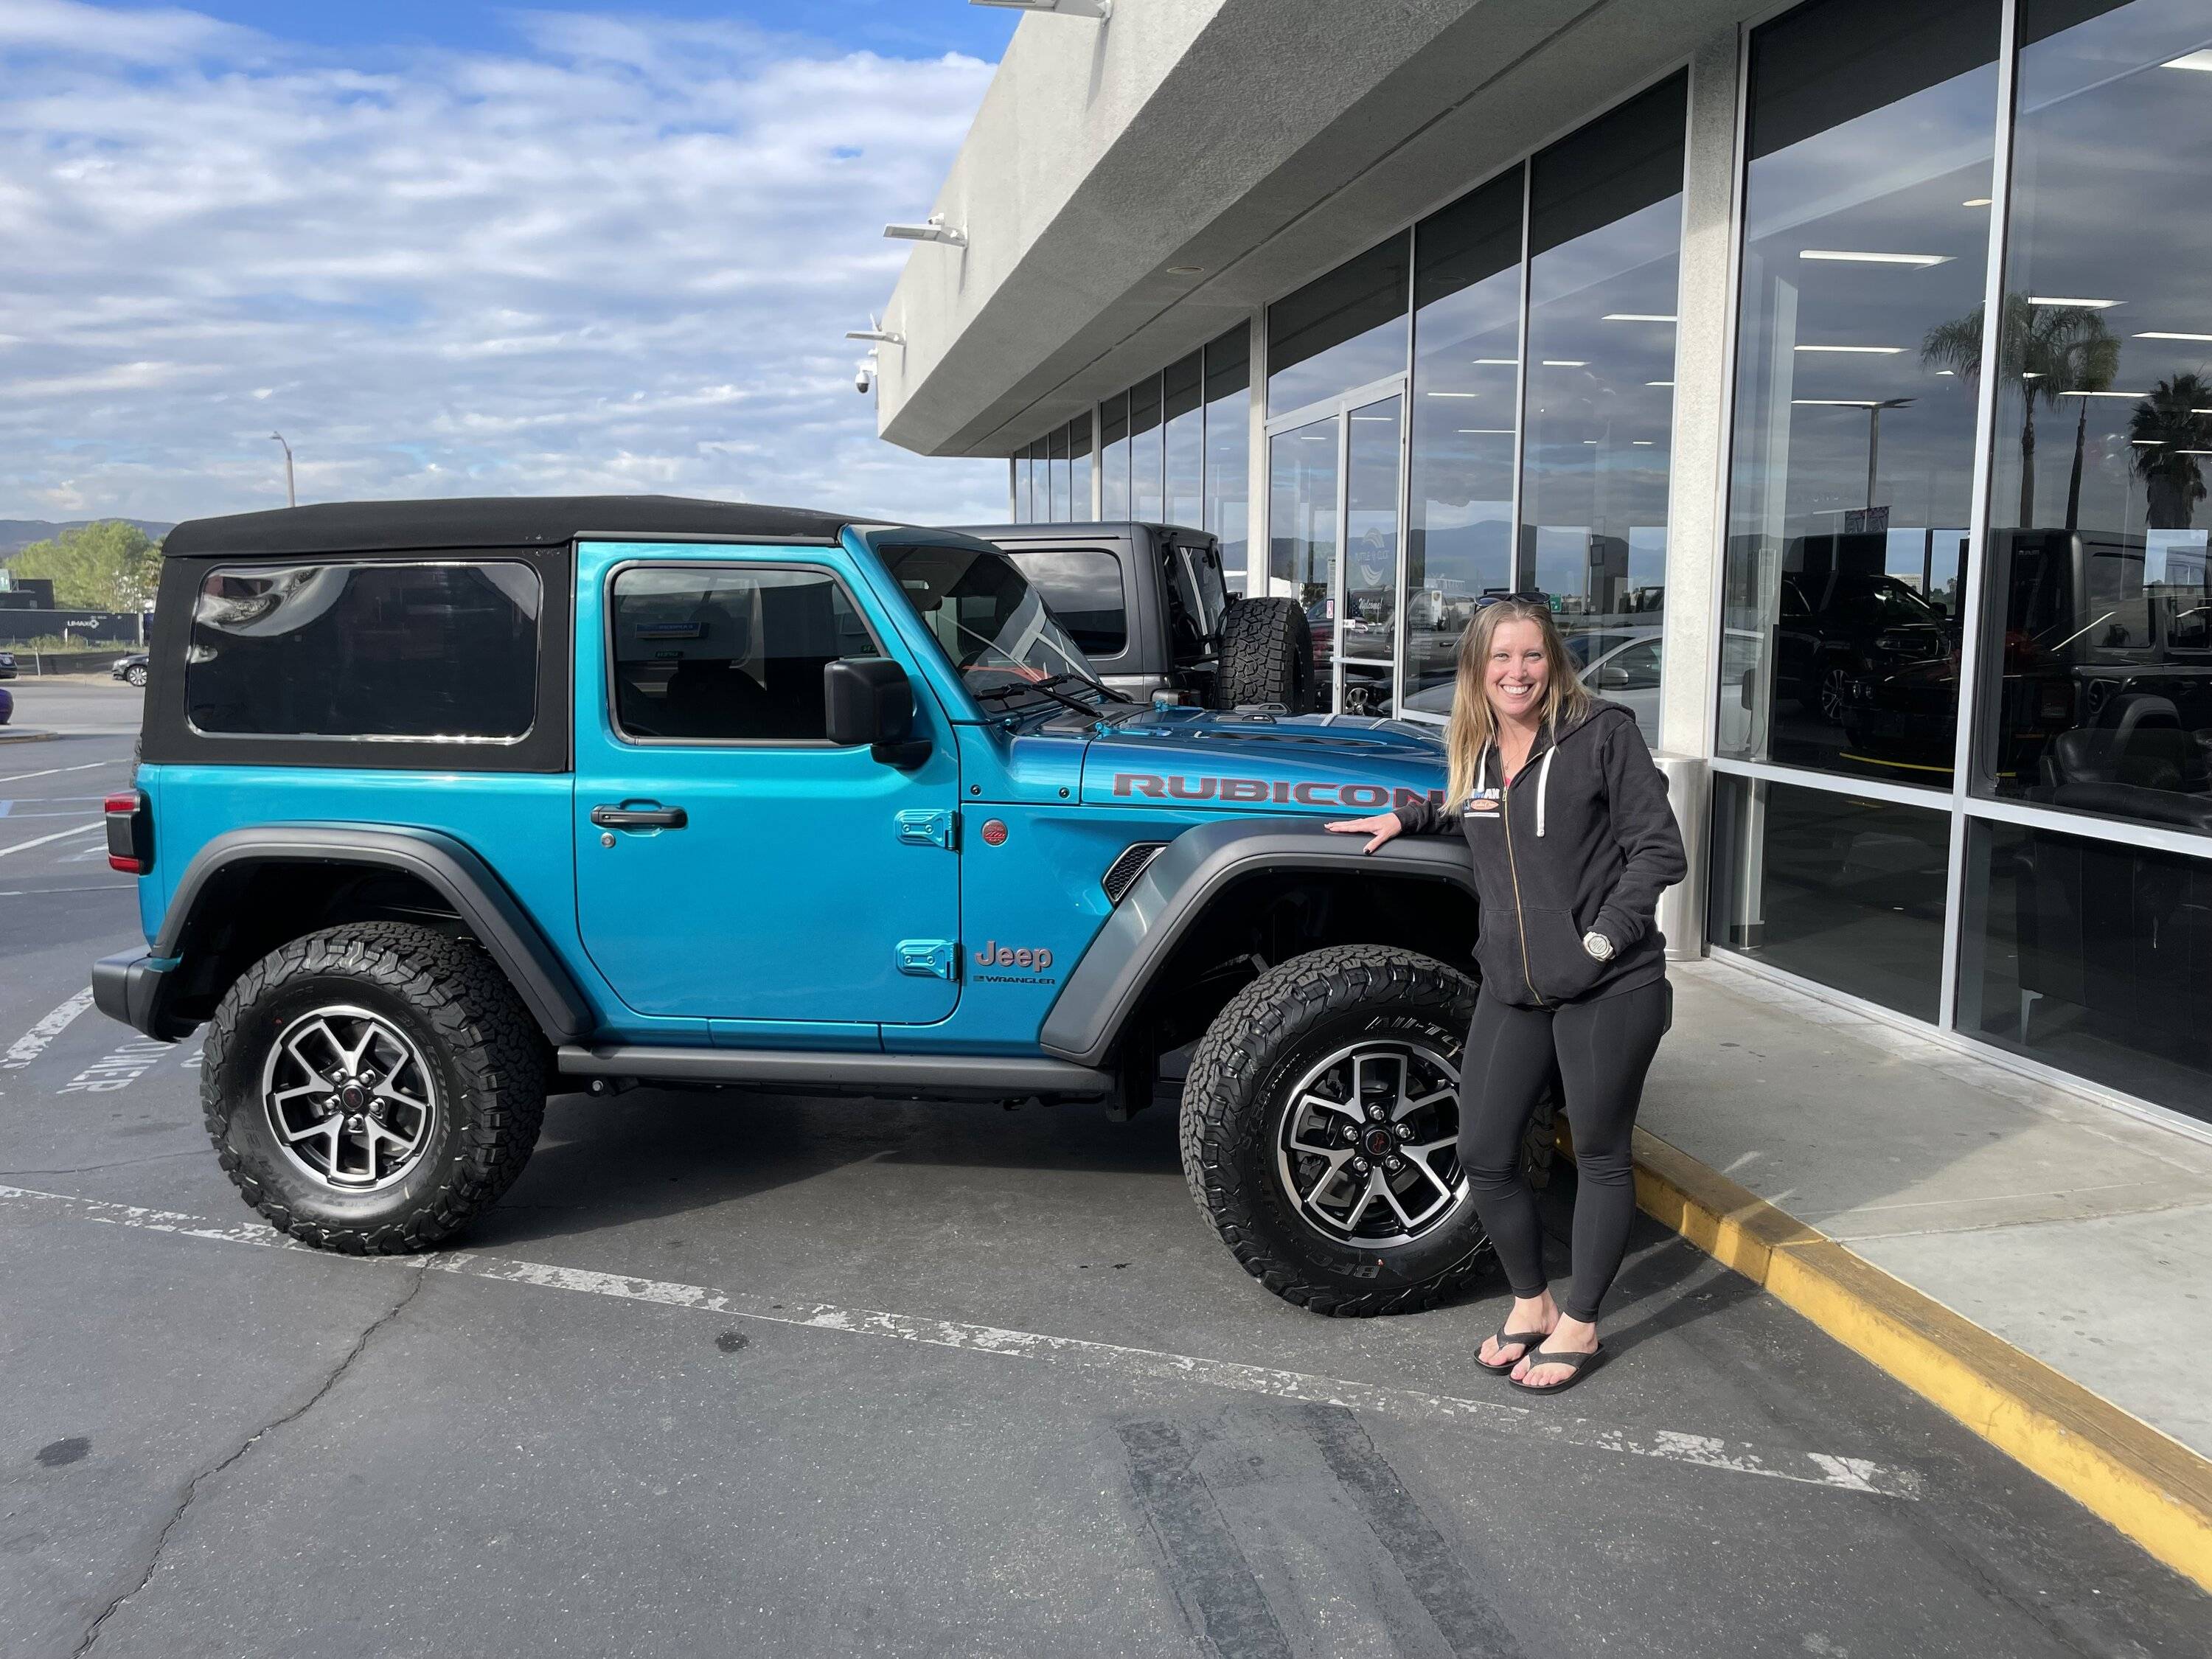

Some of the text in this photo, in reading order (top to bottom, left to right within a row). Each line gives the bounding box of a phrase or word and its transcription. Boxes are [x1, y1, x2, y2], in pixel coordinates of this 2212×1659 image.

[1358, 596, 1383, 610] Welcome!
[1113, 773, 1445, 810] RUBICON
[974, 940, 1053, 973] Jeep
[986, 975, 1055, 984] WRANGLER
